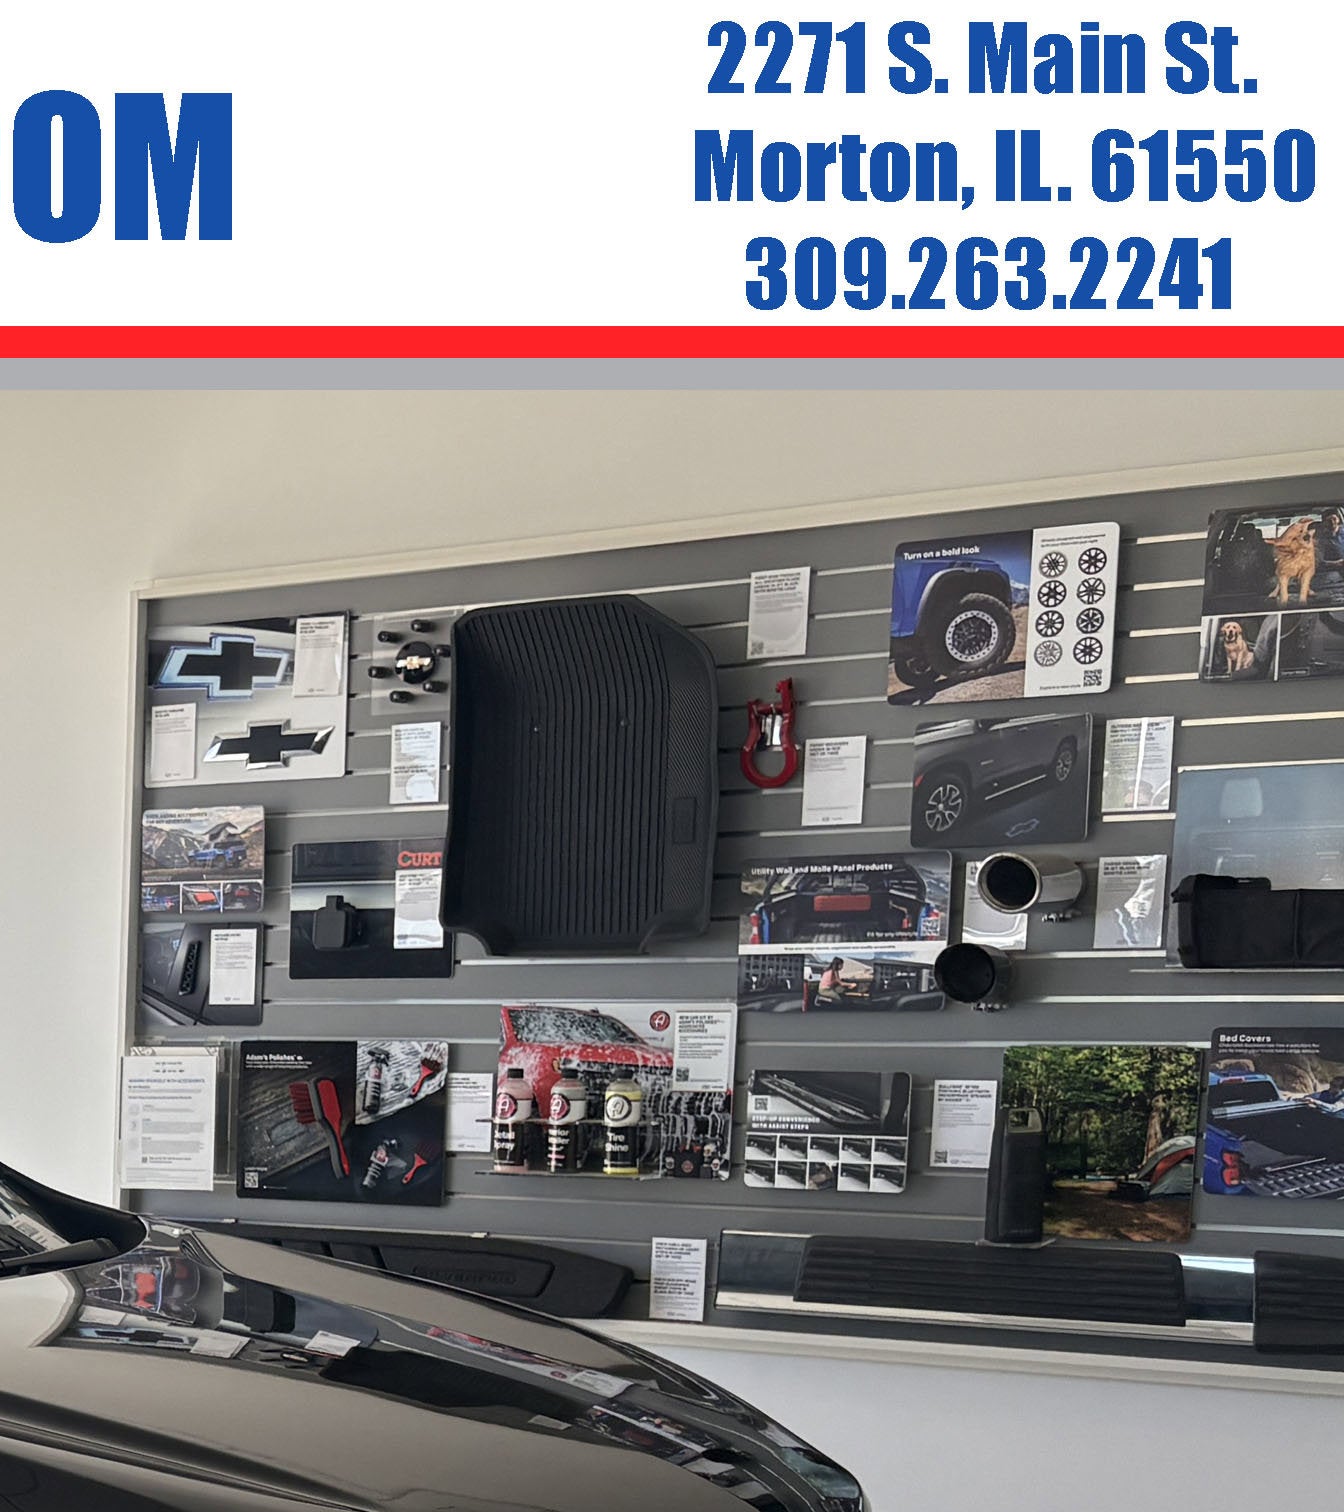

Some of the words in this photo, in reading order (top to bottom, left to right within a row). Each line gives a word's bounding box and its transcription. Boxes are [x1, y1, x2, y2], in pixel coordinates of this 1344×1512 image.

[903, 551, 921, 561] Turn
[923, 551, 933, 559] on
[941, 548, 961, 558] bold
[962, 546, 980, 556] look
[398, 851, 442, 867] CURT
[751, 867, 774, 876] Utility
[776, 867, 793, 875] Wall
[794, 865, 809, 874] and
[833, 863, 855, 872] Panel
[856, 863, 893, 872] Products
[1219, 1034, 1238, 1042] Bed
[1239, 1034, 1272, 1042] Covers
[607, 1132, 625, 1140] Tire
